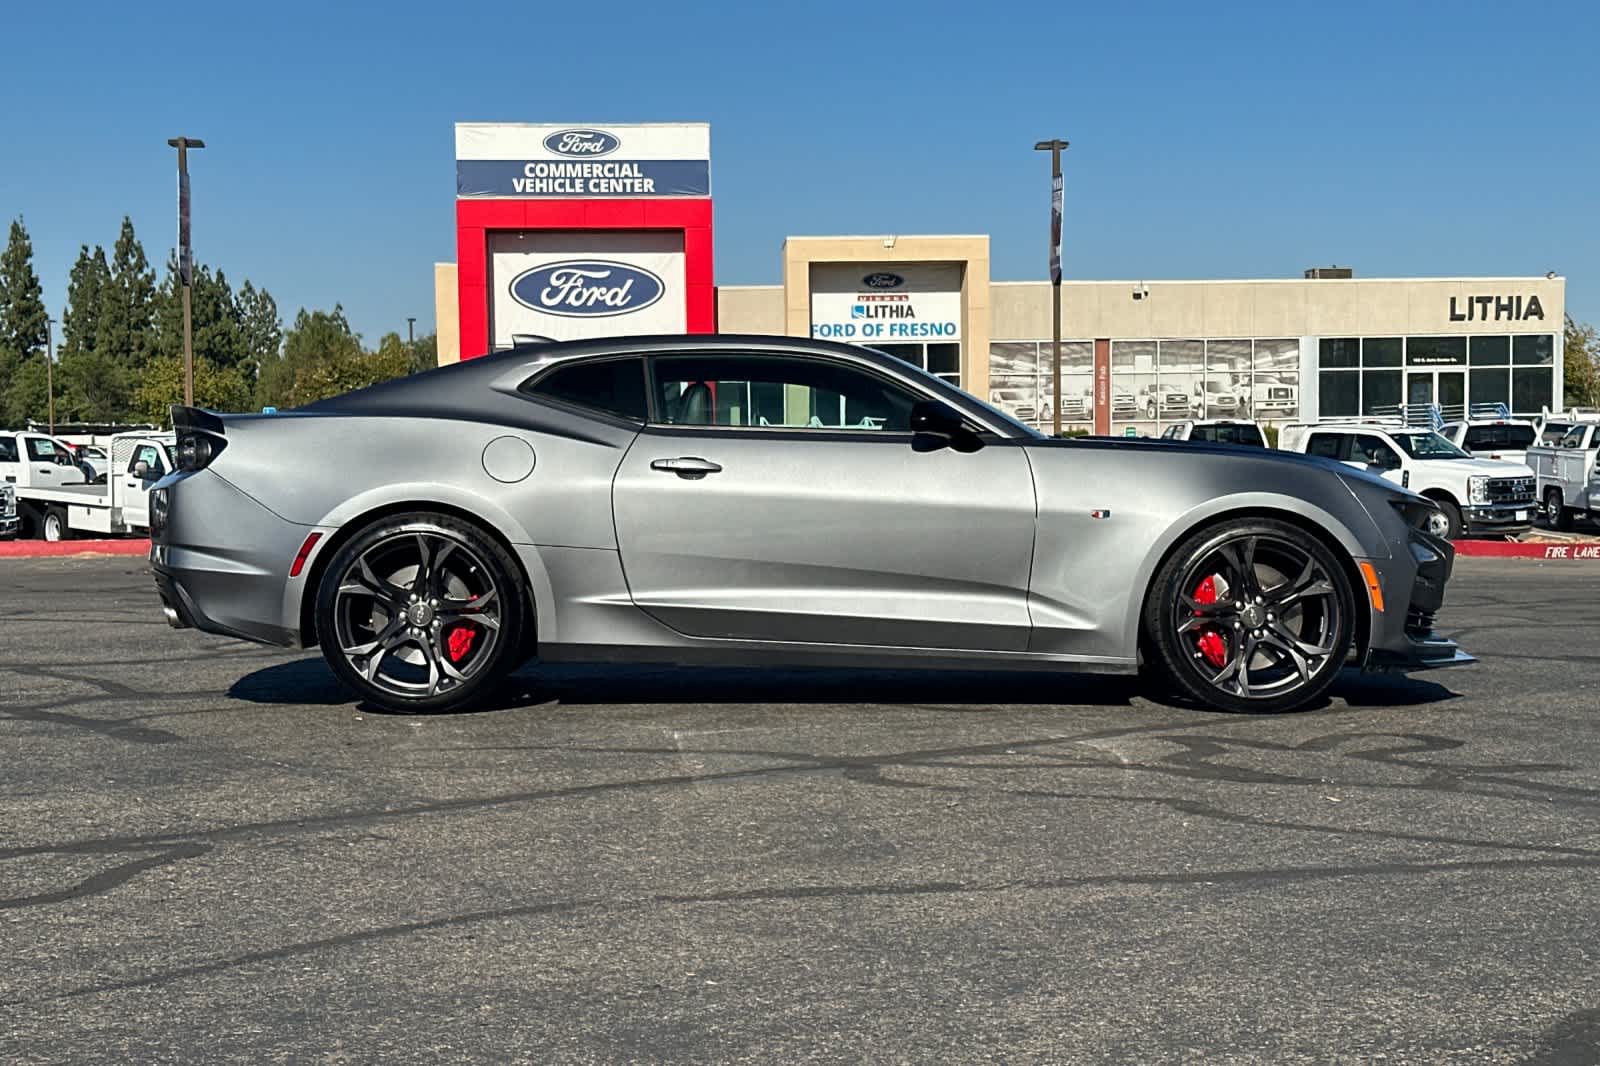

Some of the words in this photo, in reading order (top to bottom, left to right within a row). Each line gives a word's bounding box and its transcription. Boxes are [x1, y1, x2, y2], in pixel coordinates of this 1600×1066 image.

[558, 132, 605, 153] Ford
[524, 163, 643, 178] COMMERCIAL
[512, 178, 585, 193] VEHICLE
[588, 178, 655, 193] CENTER
[540, 268, 634, 307] Ford
[869, 274, 897, 287] Ford
[865, 304, 916, 319] LITHIA
[1449, 295, 1545, 321] LITHIA
[812, 323, 856, 337] FORD
[862, 323, 884, 337] OF
[889, 322, 957, 337] FRESNO
[1545, 546, 1570, 558] FIRE
[1573, 546, 1600, 558] LANE
